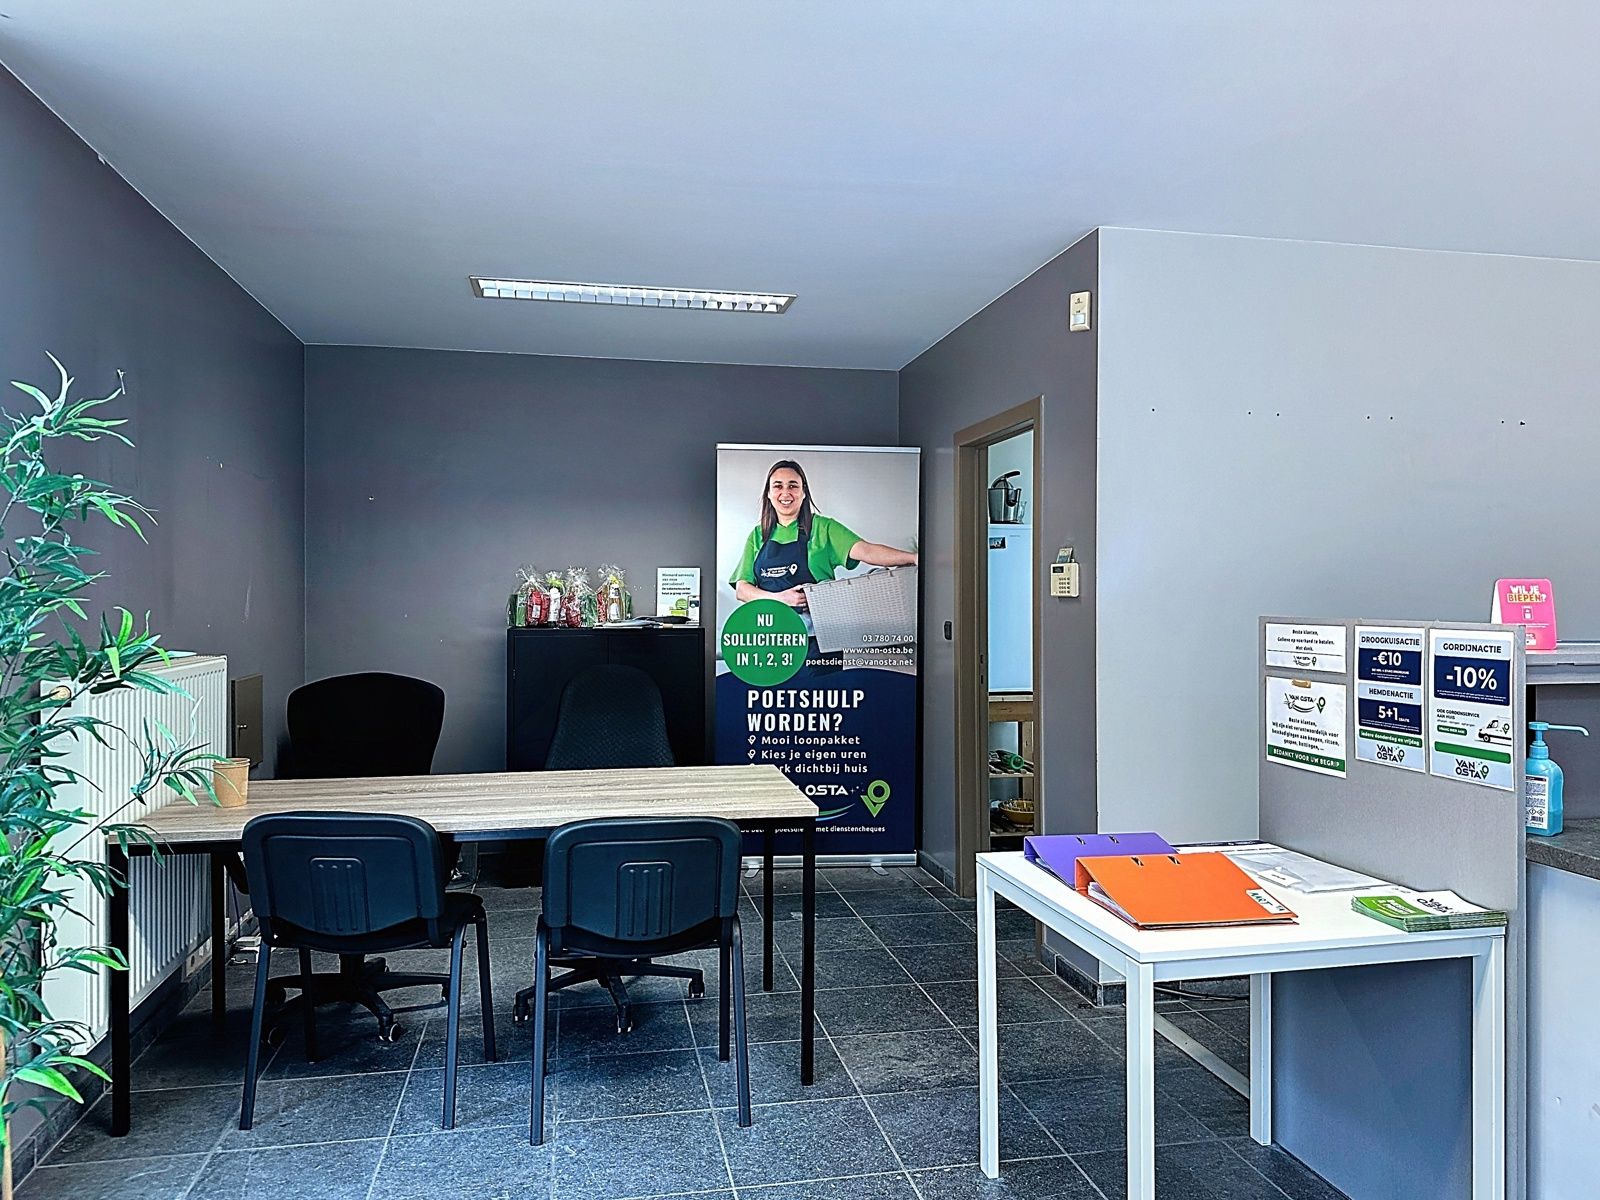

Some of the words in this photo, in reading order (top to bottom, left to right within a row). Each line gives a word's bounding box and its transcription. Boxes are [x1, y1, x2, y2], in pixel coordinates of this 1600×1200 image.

[1530, 585, 1540, 594] JE
[757, 614, 773, 626] NU
[723, 633, 806, 646] SOLLICITEREN
[1361, 636, 1420, 646] DROOGKUISACTIE
[1443, 643, 1502, 653] GORDIJNACTIE
[736, 652, 748, 666] IN
[753, 652, 762, 667] 1,
[766, 652, 778, 667] 2,
[782, 652, 793, 666] 3!
[805, 658, 913, 666] poetsdienst@vanosta.net
[1372, 651, 1402, 666] -€10
[1446, 666, 1498, 690] -10%
[748, 690, 864, 708] POETSHULP
[1368, 688, 1414, 699] HEMDENACTIE
[1378, 705, 1398, 720] 5+1
[747, 713, 843, 732] WORDEN?
[761, 736, 790, 744] Mooi
[794, 735, 860, 746] loonpakket
[1273, 748, 1294, 759] BEDANKT
[1376, 744, 1393, 753] VAN
[761, 750, 786, 759] Kies
[789, 750, 800, 760] je
[805, 750, 836, 760] eigen
[1376, 751, 1399, 762] OSTA
[780, 764, 790, 773] rk
[795, 764, 840, 774] dichtbij
[844, 764, 868, 773] huis
[1456, 758, 1475, 769] VAN
[1455, 767, 1481, 779] OSTA
[805, 784, 848, 796] OSTA
